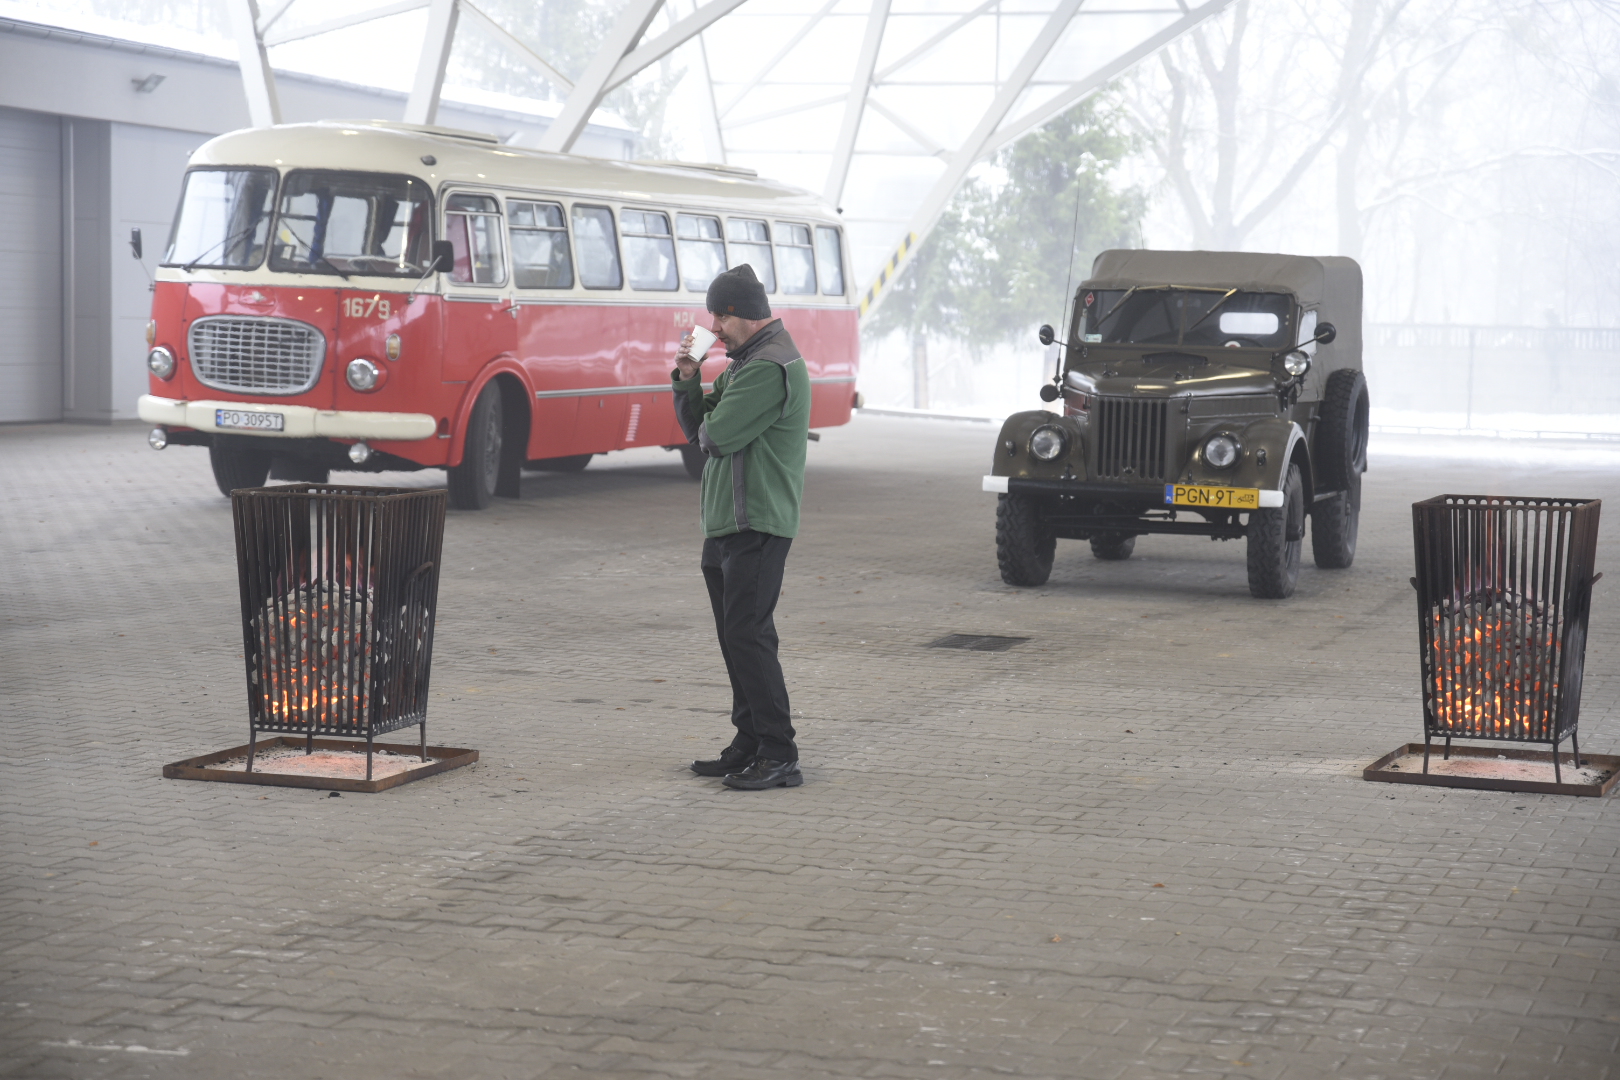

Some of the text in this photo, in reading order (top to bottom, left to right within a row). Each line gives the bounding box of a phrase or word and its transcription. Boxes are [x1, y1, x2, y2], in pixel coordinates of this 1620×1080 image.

[342, 297, 391, 320] 1679
[223, 412, 280, 429] PO 3095T
[1175, 487, 1210, 505] PGN
[1215, 489, 1235, 506] 9T
